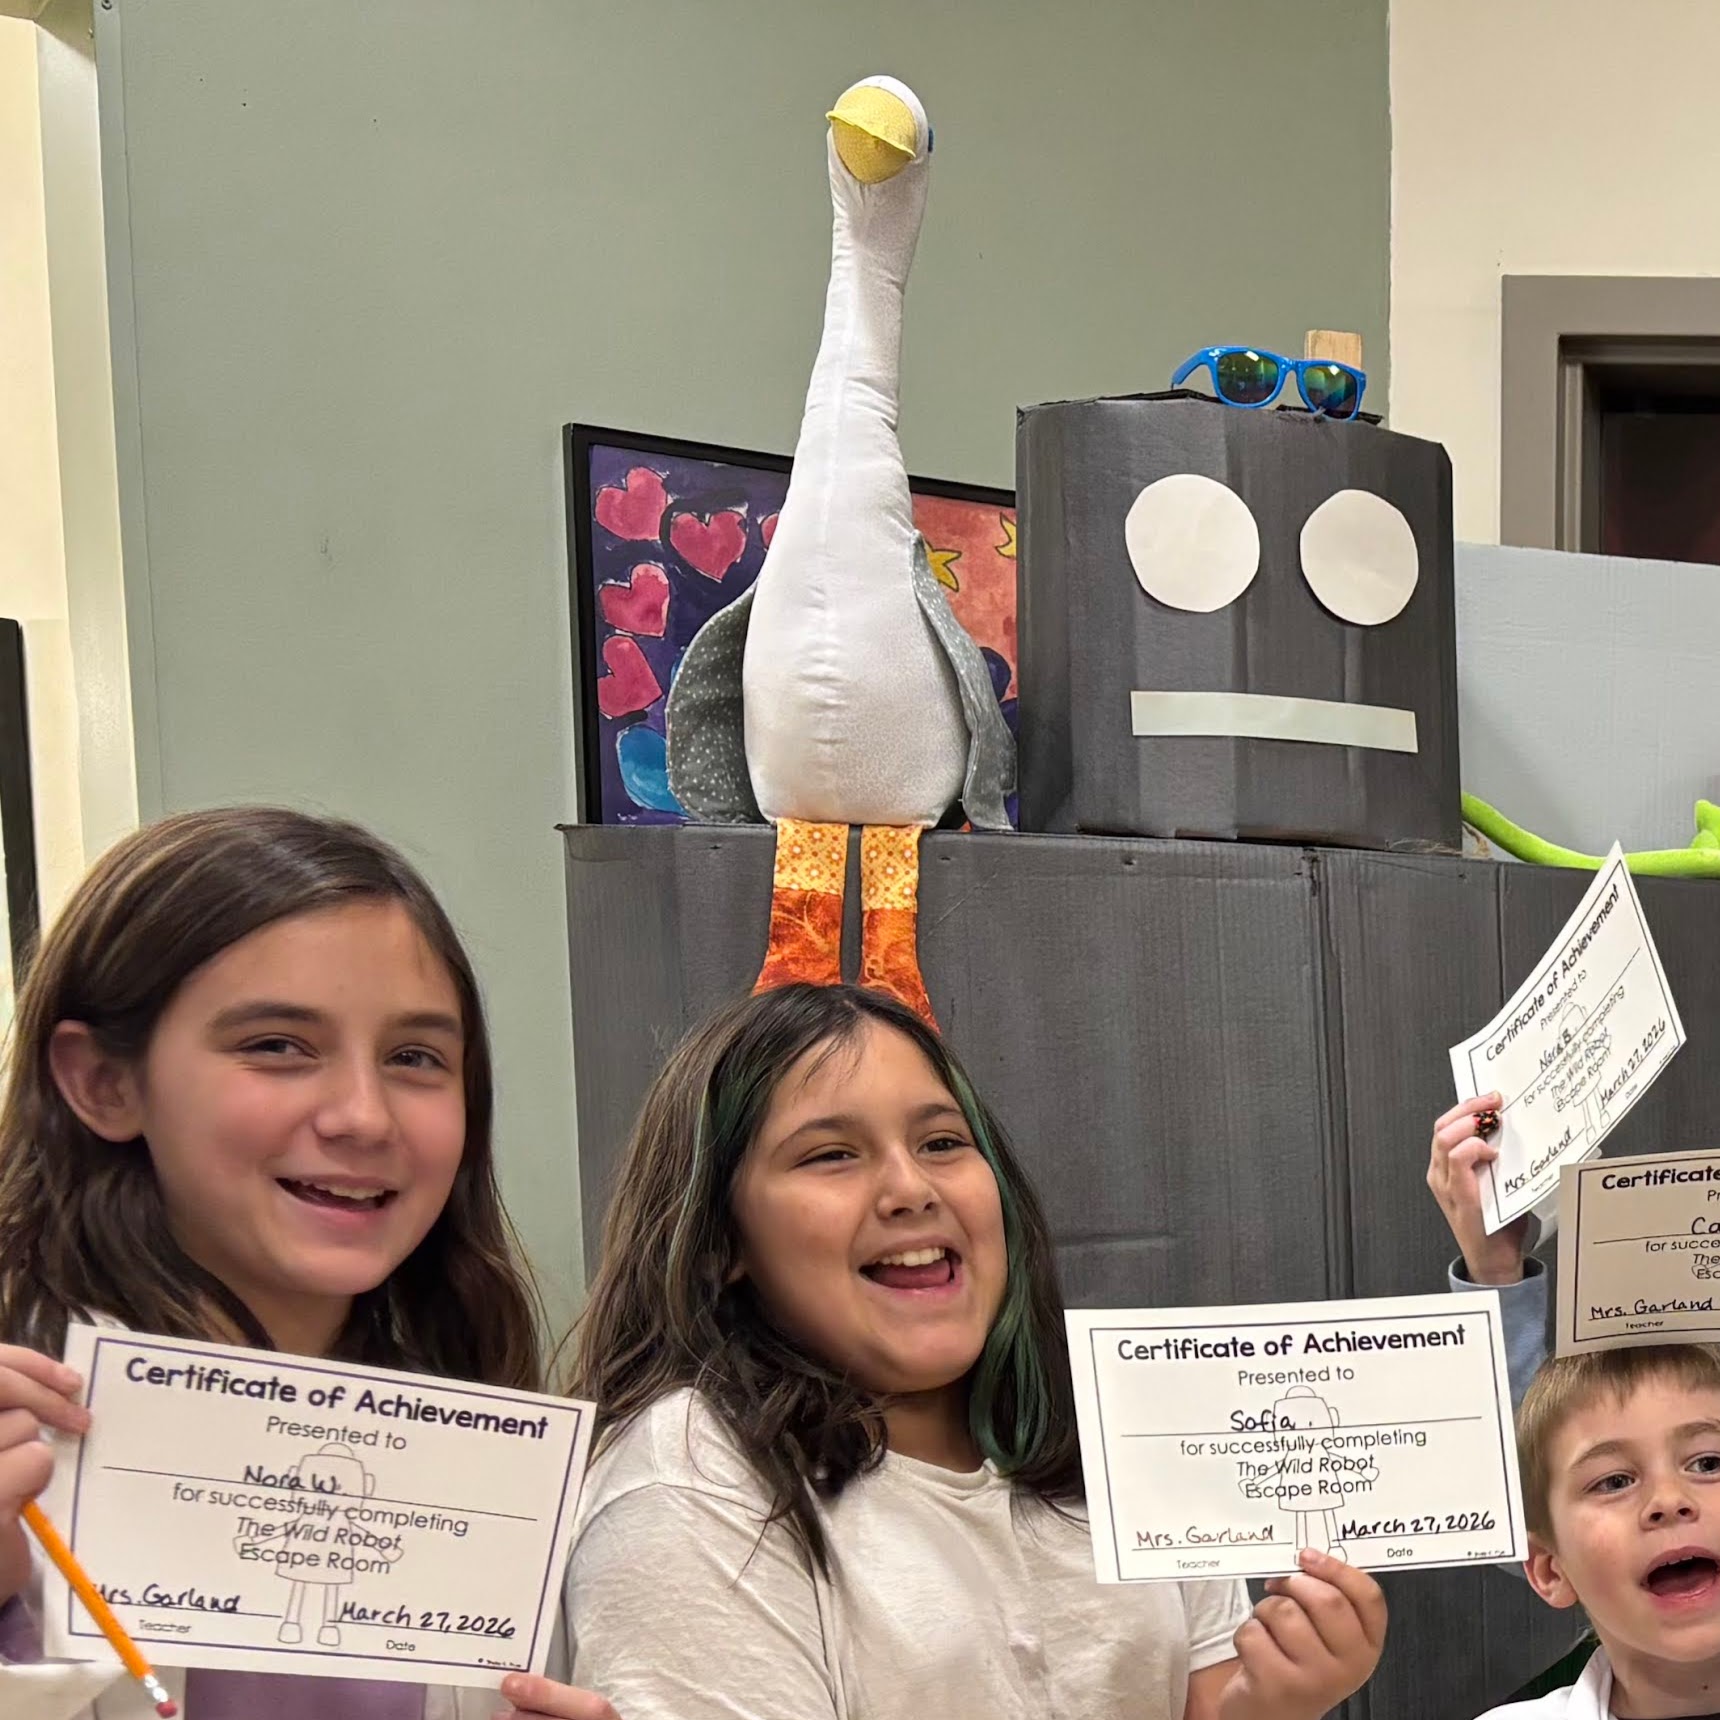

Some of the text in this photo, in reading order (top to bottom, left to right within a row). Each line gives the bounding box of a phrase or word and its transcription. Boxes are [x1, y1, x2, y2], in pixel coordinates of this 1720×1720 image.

[1486, 883, 1620, 1061] Certificate of Achievement
[1646, 1240, 1667, 1253] for
[1693, 1253, 1720, 1265] The
[1590, 1297, 1713, 1320] Mrs. Garland
[1118, 1324, 1466, 1360] Certificate of Achievement
[1238, 1366, 1354, 1386] Presented to
[126, 1357, 548, 1439] Certificate of Achievement
[266, 1415, 407, 1450] Presented to
[1180, 1429, 1426, 1456] for successfully completing
[243, 1465, 305, 1490] Nora
[1237, 1454, 1375, 1477] The Wild Robot
[1245, 1478, 1373, 1500] Escape Room
[172, 1482, 469, 1537] for successfully completing
[237, 1516, 402, 1551] The Wild Robot
[1136, 1524, 1274, 1549] Mrs. Garland
[1342, 1510, 1495, 1540] March 27, 2026
[239, 1543, 391, 1575] Escape Room
[142, 1583, 240, 1612] Garland
[339, 1601, 516, 1638] March 27, 2026
